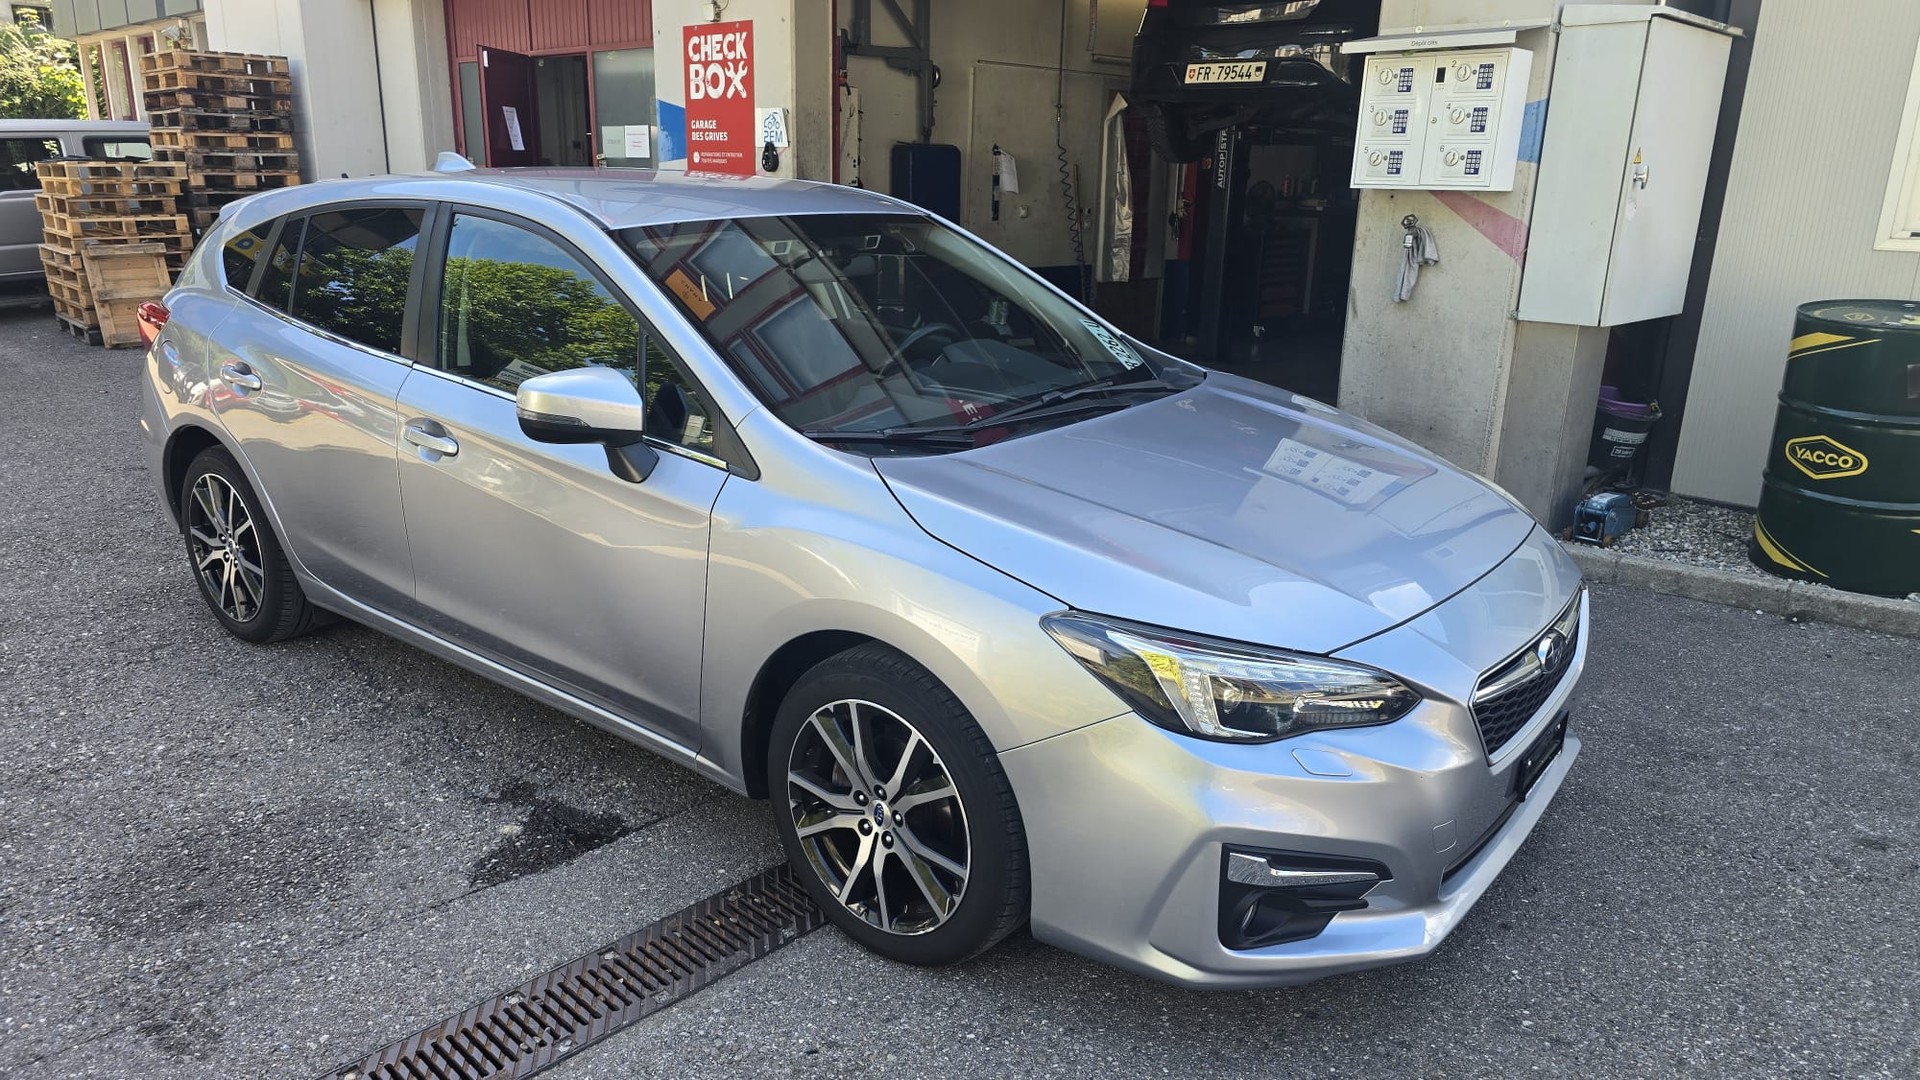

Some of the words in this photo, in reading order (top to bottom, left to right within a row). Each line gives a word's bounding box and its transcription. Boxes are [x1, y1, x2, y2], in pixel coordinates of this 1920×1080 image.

[688, 32, 748, 61] CHECK
[689, 61, 748, 99] BOX
[691, 119, 717, 129] GARAGE
[691, 131, 704, 141] DES
[704, 131, 728, 141] GRIVES
[1794, 445, 1854, 470] YACCO
